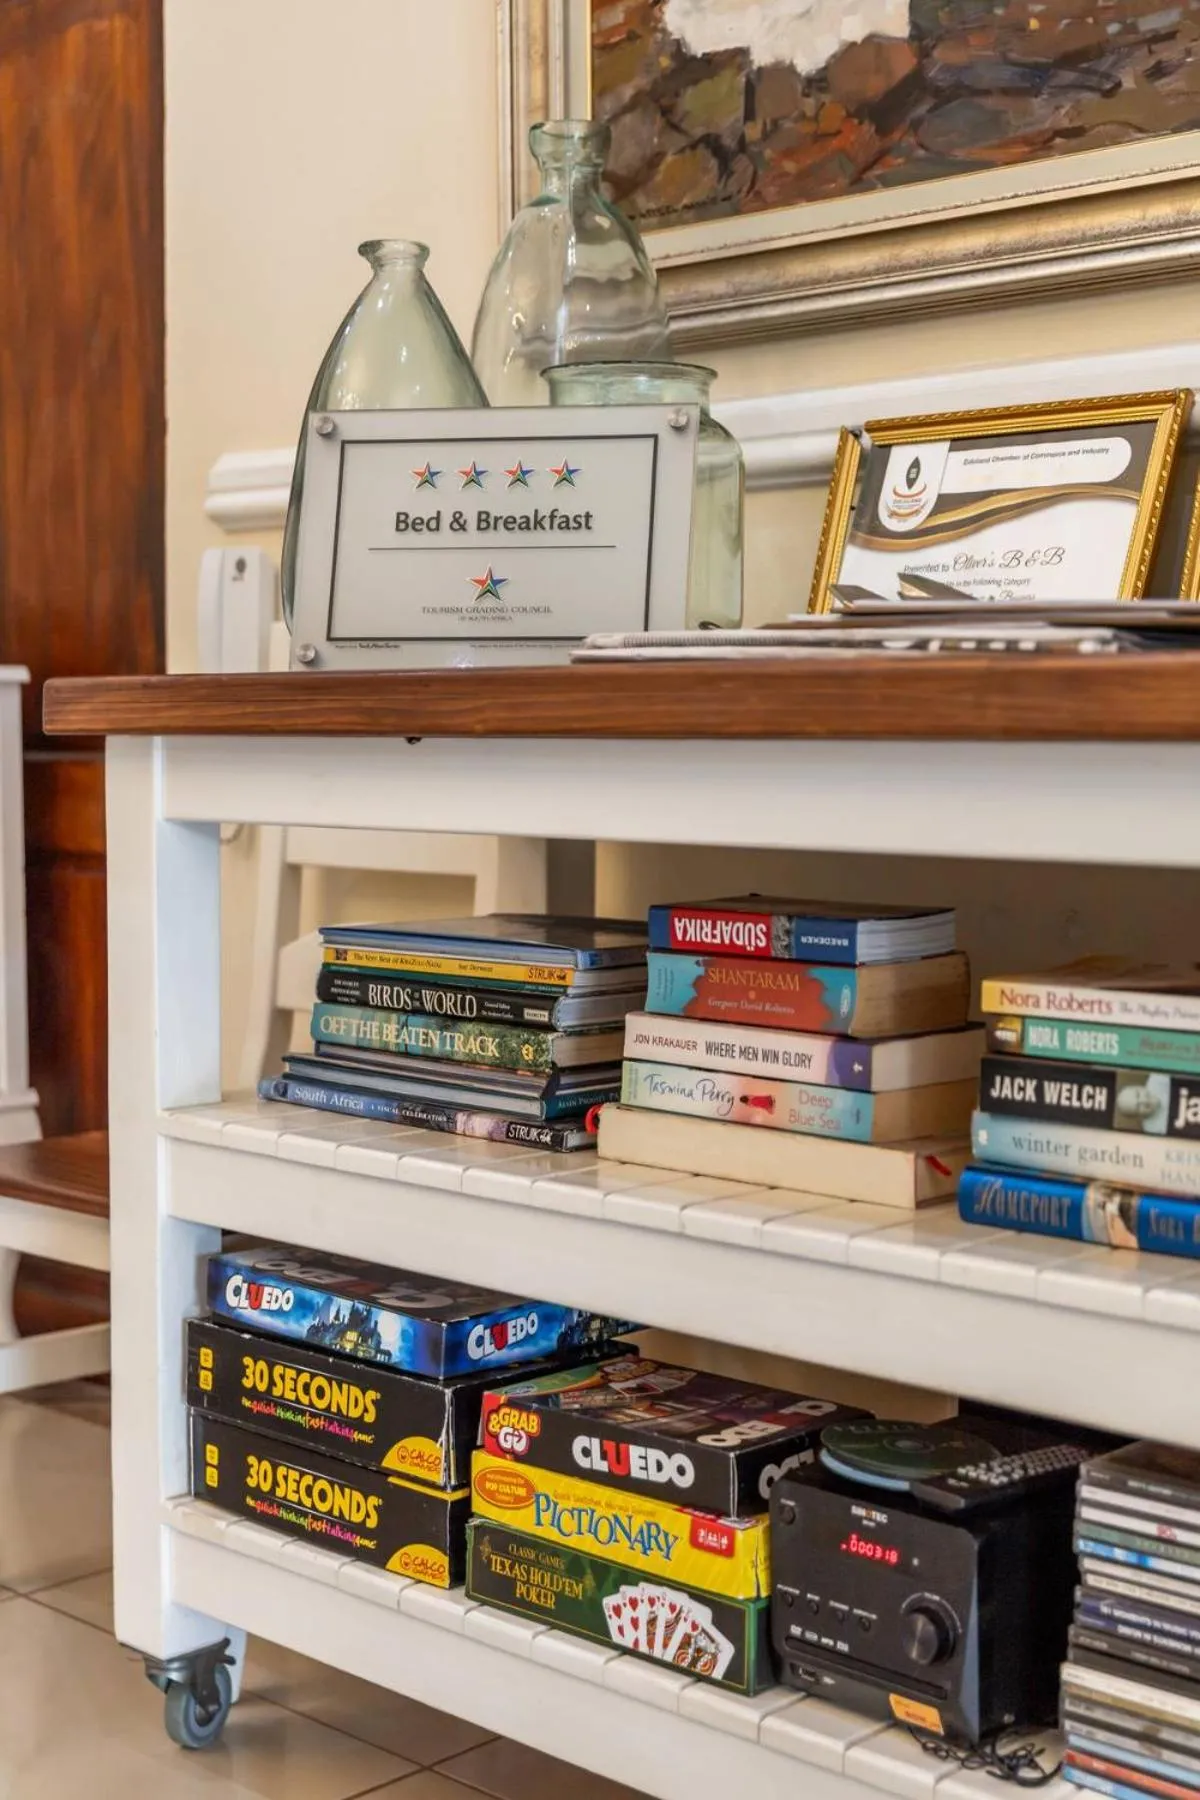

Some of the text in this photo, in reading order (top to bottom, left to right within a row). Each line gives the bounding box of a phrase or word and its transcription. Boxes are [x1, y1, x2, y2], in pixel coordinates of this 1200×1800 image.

[395, 508, 593, 532] Bed & Breakfast
[422, 605, 463, 615] TOURISM
[511, 605, 553, 615] COUNCIL
[674, 917, 768, 951] SÜDAFRIKA
[528, 967, 556, 980] STRUIK
[708, 967, 800, 991] SHANTARAM
[368, 983, 412, 1010] BIRDS
[421, 989, 477, 1018] WORLD
[1000, 988, 1041, 1010] Nora
[1046, 990, 1113, 1015] Roberts
[320, 1015, 499, 1057] OFF THE BEATEN TRACK
[633, 1033, 813, 1069] JON KRAKAUER WHERE MEN WIN GLORY
[1029, 1025, 1060, 1049] NORA
[1067, 1028, 1120, 1056] ROBERTS
[643, 1073, 695, 1100] Tasmina
[696, 1078, 734, 1116] Perry
[799, 1089, 833, 1109] Deep
[990, 1074, 1037, 1103] JACK
[1043, 1080, 1107, 1112] WELCH
[294, 1087, 327, 1104] South
[329, 1094, 364, 1111] Africa
[508, 1124, 541, 1142] STRUIK
[788, 1108, 842, 1131] Blue Sea
[1012, 1133, 1144, 1169] winter garden
[226, 1274, 295, 1312] CLUEDO
[467, 1312, 538, 1360] CLUEDO
[241, 1356, 269, 1392] 30
[498, 1426, 528, 1452] GO
[246, 1455, 273, 1492] 30
[409, 1448, 441, 1466] CALCO
[572, 1435, 696, 1489] CLUEDO
[534, 1492, 679, 1561] PICTIONARY
[412, 1556, 446, 1574] CALCO
[509, 1543, 565, 1569] CLASSIC GAMES
[490, 1553, 583, 1599] TEXAS HOLD'EM
[516, 1581, 556, 1610] POKER
